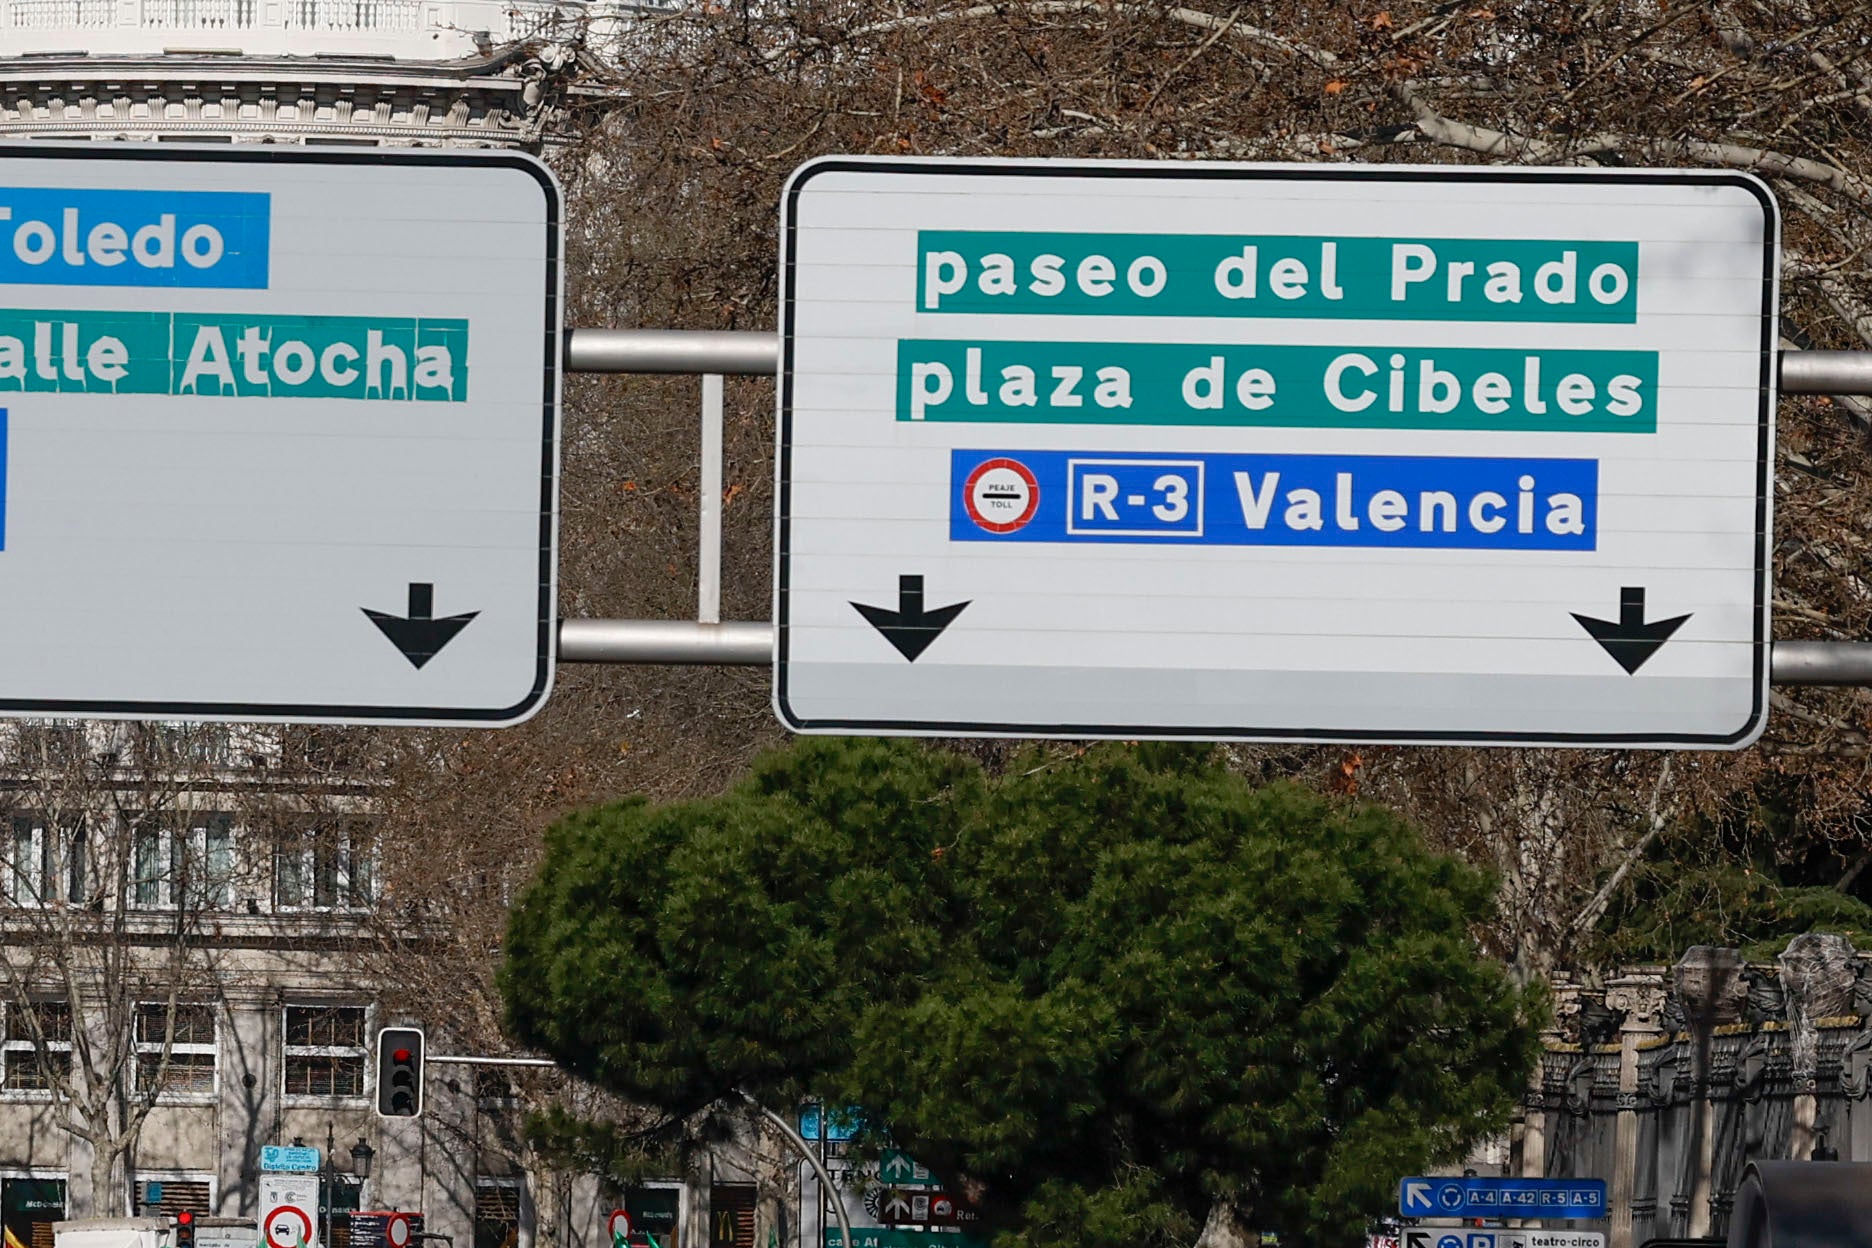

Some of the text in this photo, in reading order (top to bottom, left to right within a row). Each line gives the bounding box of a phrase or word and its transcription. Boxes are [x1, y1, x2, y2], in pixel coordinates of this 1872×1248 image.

[923, 241, 1631, 309] paseo del Prado
[179, 324, 455, 390] Atocha
[908, 348, 1645, 420] plaza de Cibeles
[987, 483, 1017, 493] PEAJE
[990, 499, 1013, 509] TOLL
[1080, 472, 1587, 536] R-3 Valencia
[1469, 1190, 1598, 1205] A-4 A-42 R-5 A-5
